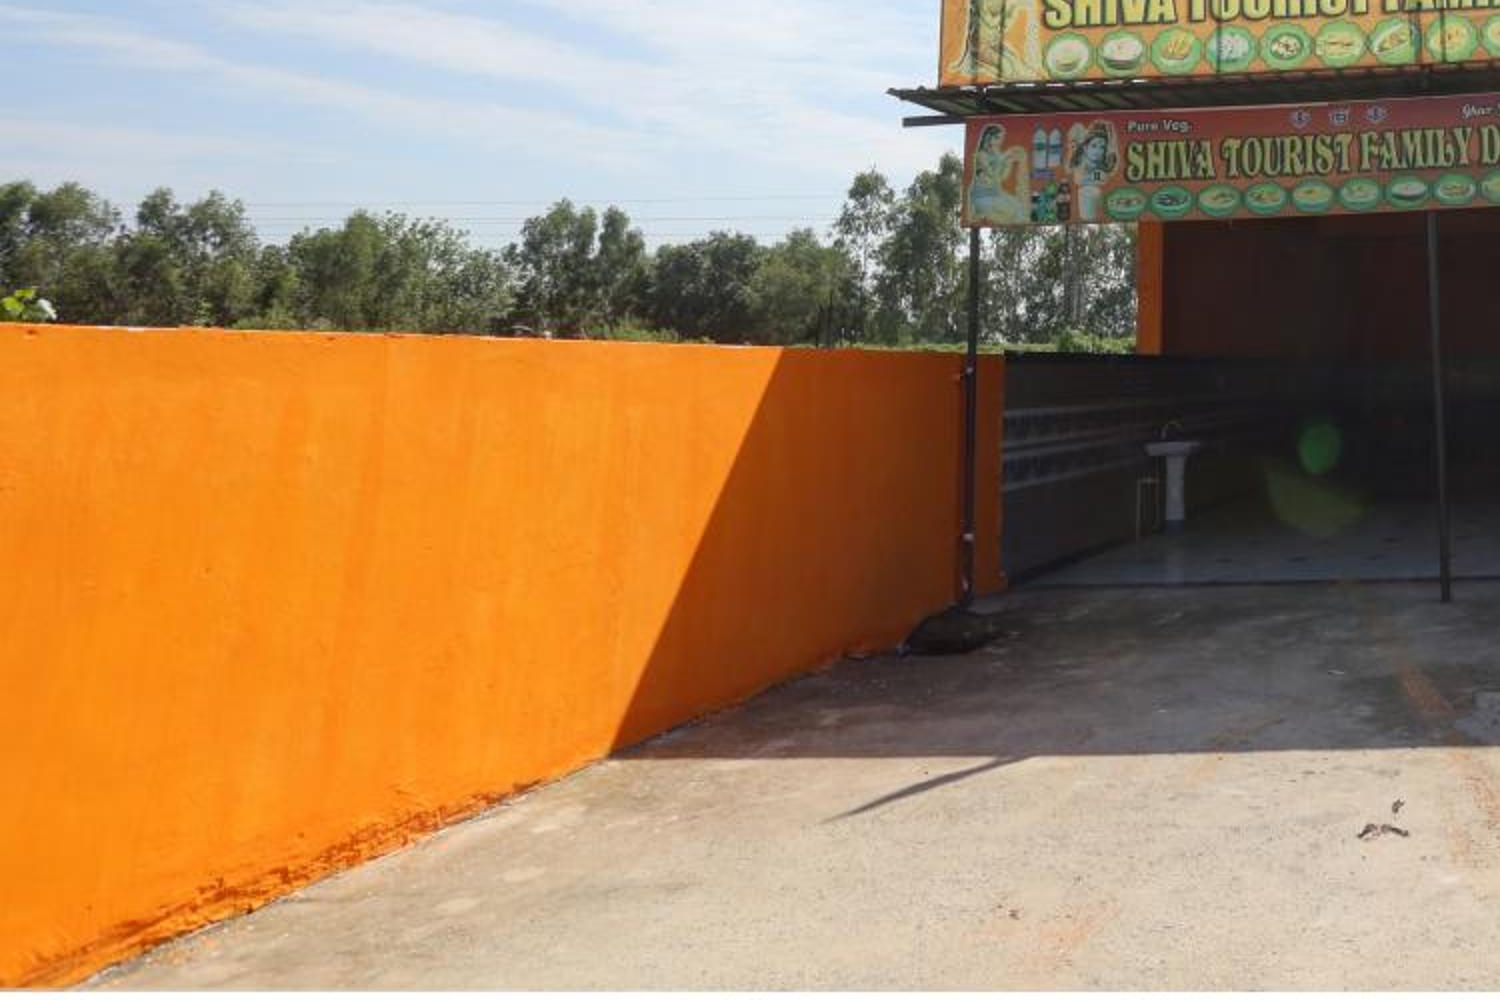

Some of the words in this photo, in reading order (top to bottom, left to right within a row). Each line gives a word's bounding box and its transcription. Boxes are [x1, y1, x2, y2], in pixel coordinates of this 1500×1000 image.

[1127, 120, 1159, 133] Pure
[1125, 137, 1216, 182] SHIVA
[1221, 132, 1356, 177] TOURIST
[1360, 123, 1473, 171] FAMILY
